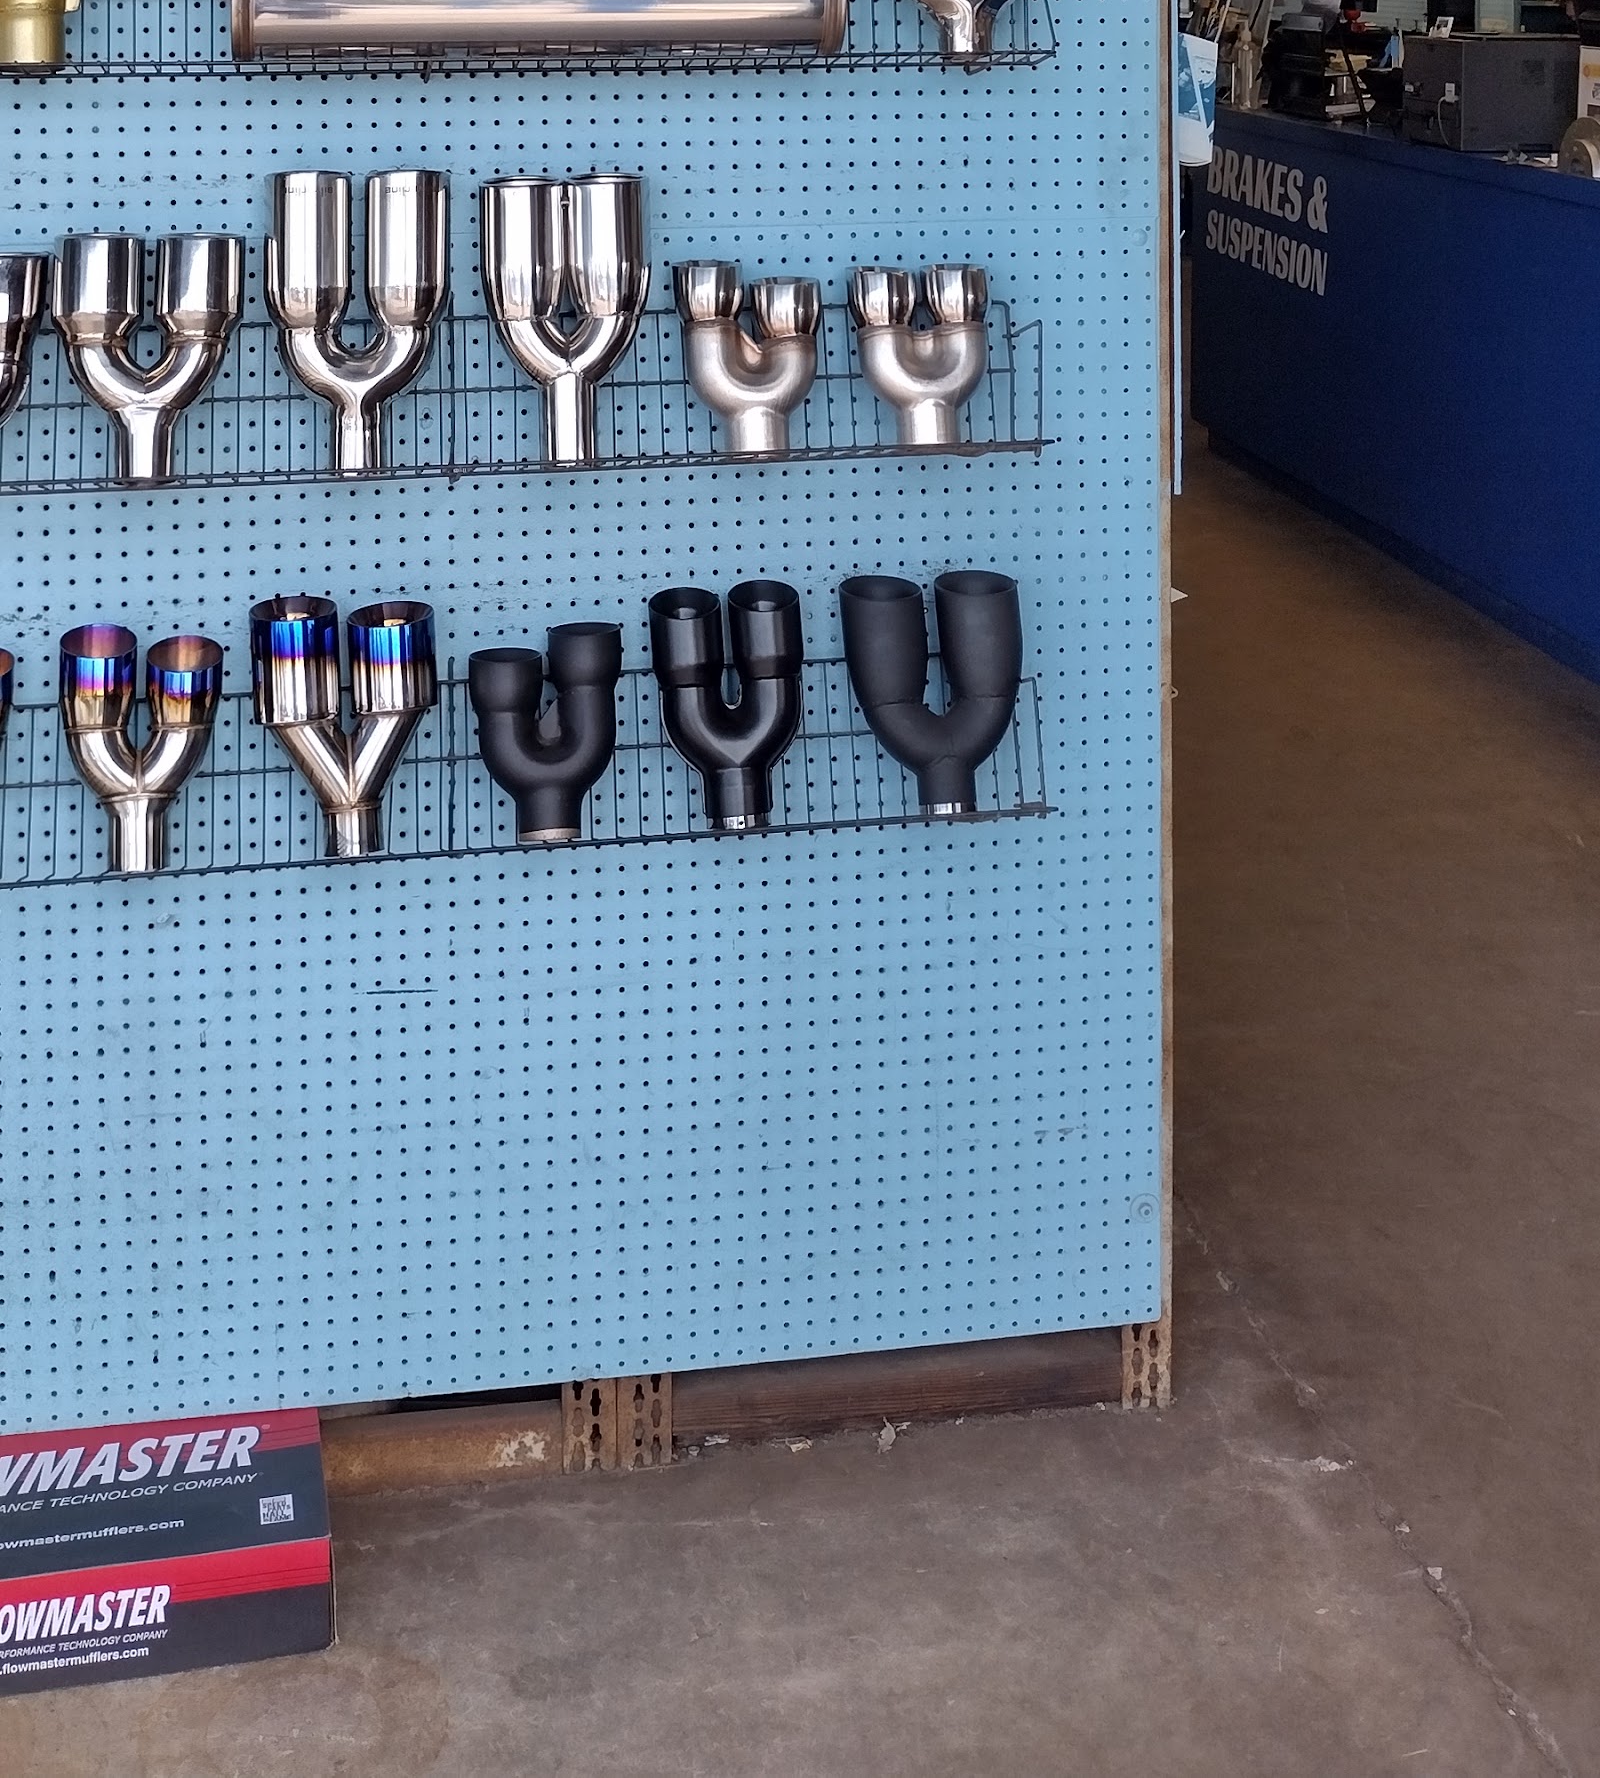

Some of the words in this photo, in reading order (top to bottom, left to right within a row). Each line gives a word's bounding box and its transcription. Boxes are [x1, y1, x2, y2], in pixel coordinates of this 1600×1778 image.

[1206, 145, 1304, 222] BRAKES
[1307, 175, 1328, 233] &
[1205, 209, 1328, 296] SUSPENSION
[50, 1484, 168, 1508] TECHNOLOGY
[172, 1472, 258, 1492] COMPANY
[0, 1584, 171, 1644] OWMASTER
[58, 1635, 121, 1652] TECHNOLOGY
[122, 1629, 168, 1643] COMPANY
